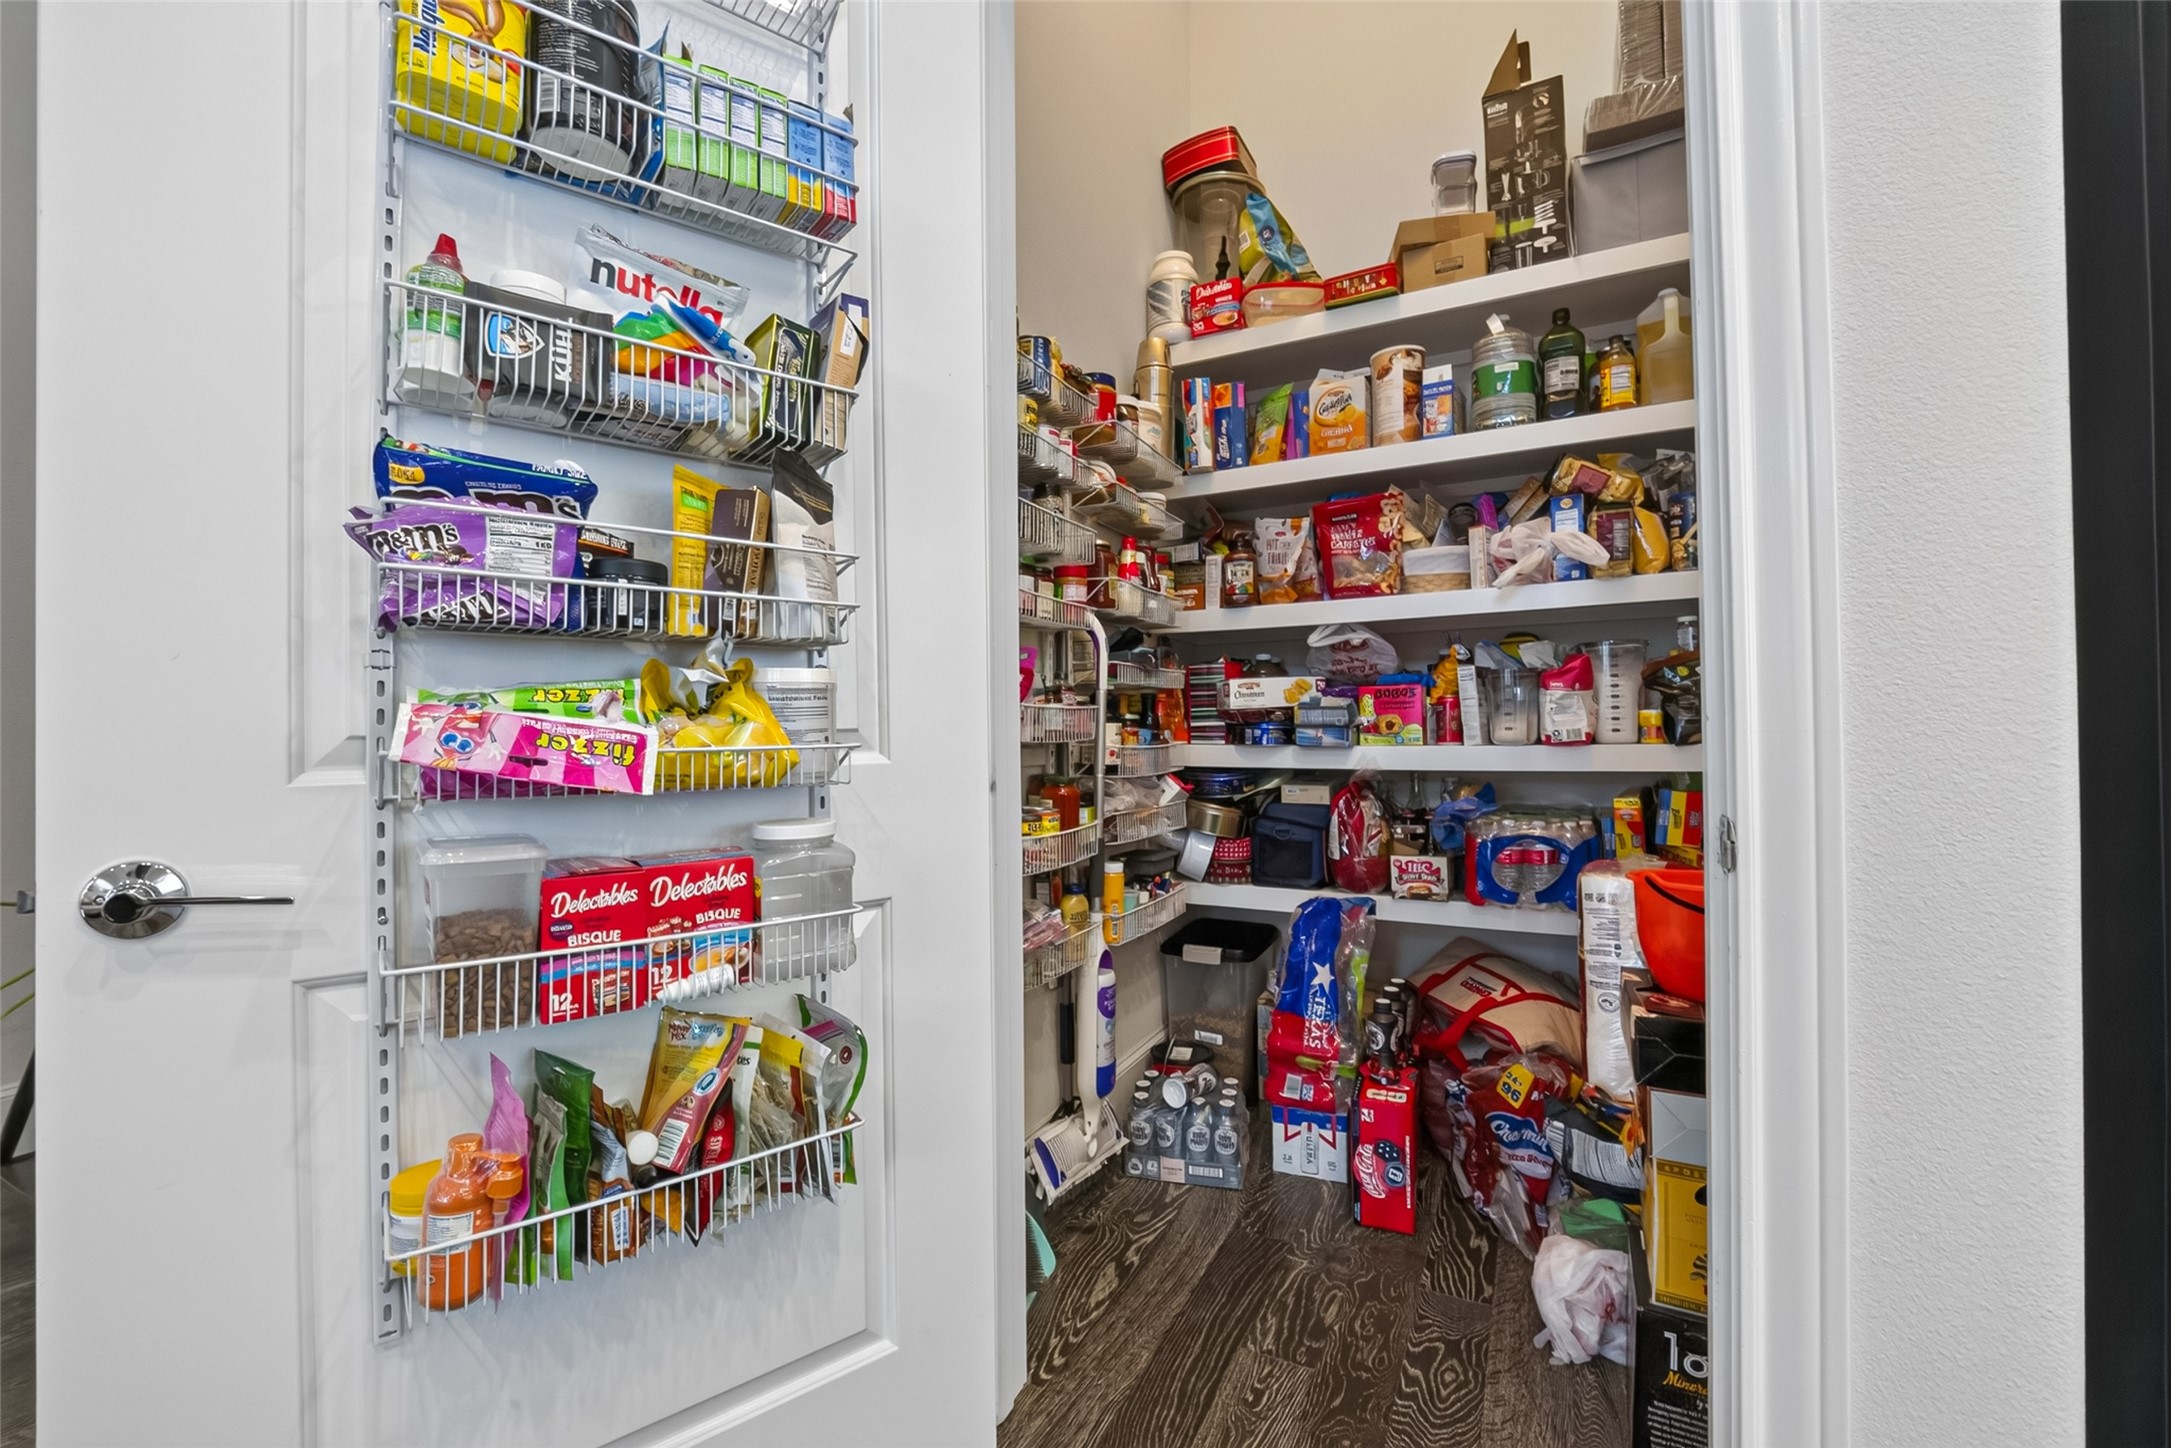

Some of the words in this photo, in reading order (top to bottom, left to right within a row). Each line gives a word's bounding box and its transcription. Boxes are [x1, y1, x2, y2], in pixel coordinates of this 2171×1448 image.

[532, 688, 625, 705] zzer
[535, 732, 636, 767] fizzer
[649, 863, 748, 907] Delectables
[550, 881, 639, 918] Delectables
[696, 908, 742, 925] BISQUE
[567, 929, 622, 947] BISQUE
[1501, 1081, 1522, 1103] 96
